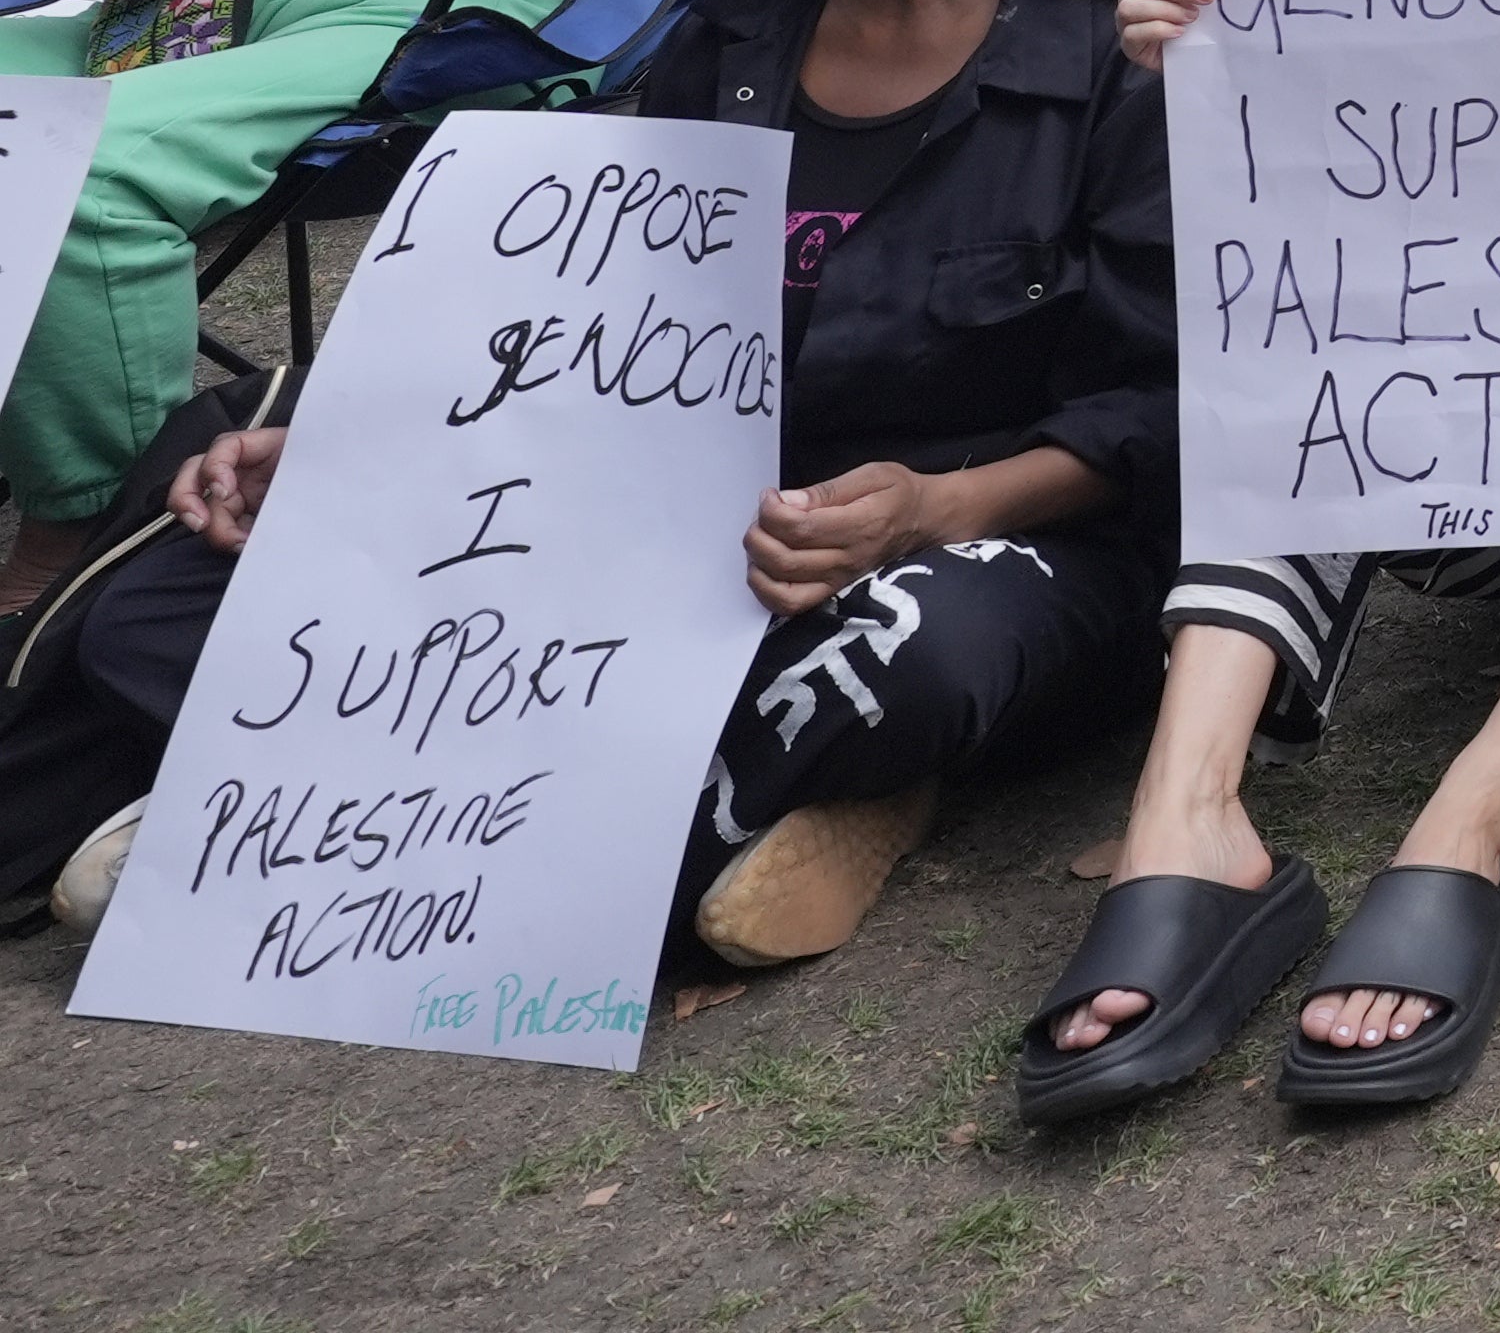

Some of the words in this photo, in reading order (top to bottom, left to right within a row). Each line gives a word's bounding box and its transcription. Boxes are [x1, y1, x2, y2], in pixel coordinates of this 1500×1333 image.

[1241, 94, 1258, 204] I
[373, 150, 458, 262] I
[493, 162, 748, 287] OPPOSE
[419, 477, 531, 578] I
[1422, 502, 1491, 540] THIS
[232, 608, 628, 755] SUPPORT
